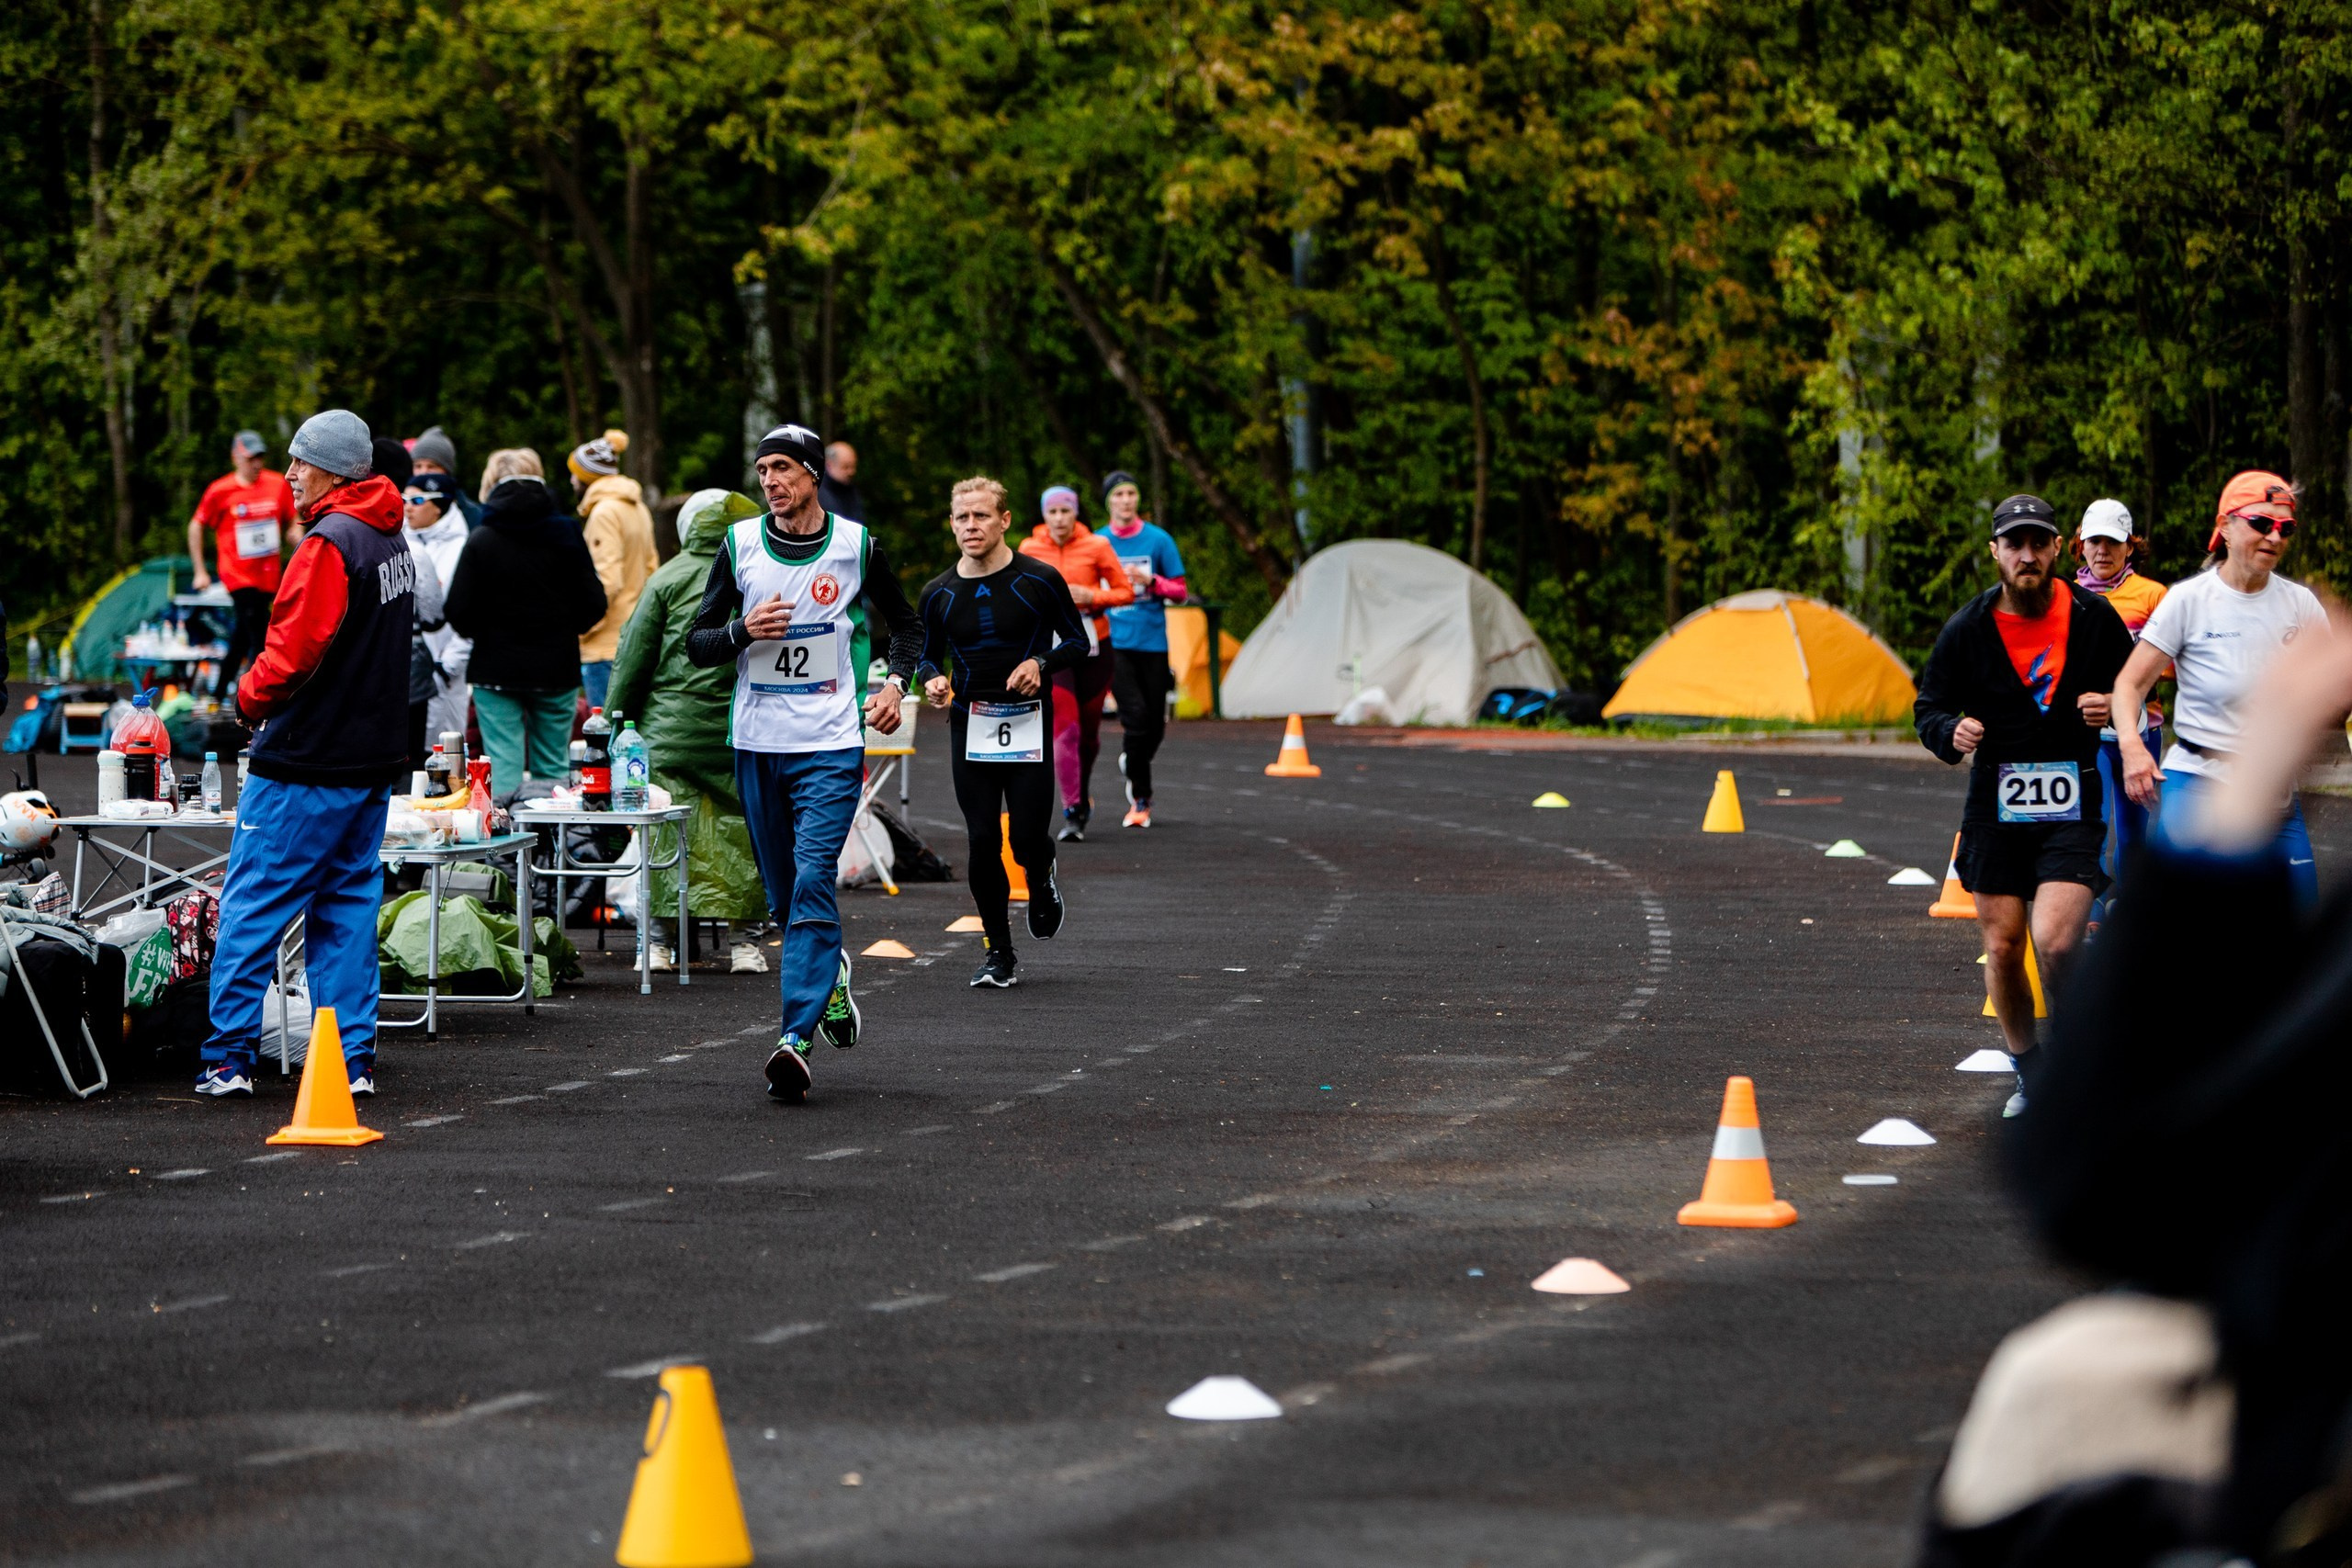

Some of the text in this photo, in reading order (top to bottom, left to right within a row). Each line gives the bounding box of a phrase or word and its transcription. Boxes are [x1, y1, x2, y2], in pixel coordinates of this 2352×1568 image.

[775, 646, 809, 678] 42
[998, 722, 1012, 747] 6
[2006, 776, 2072, 807] 210
